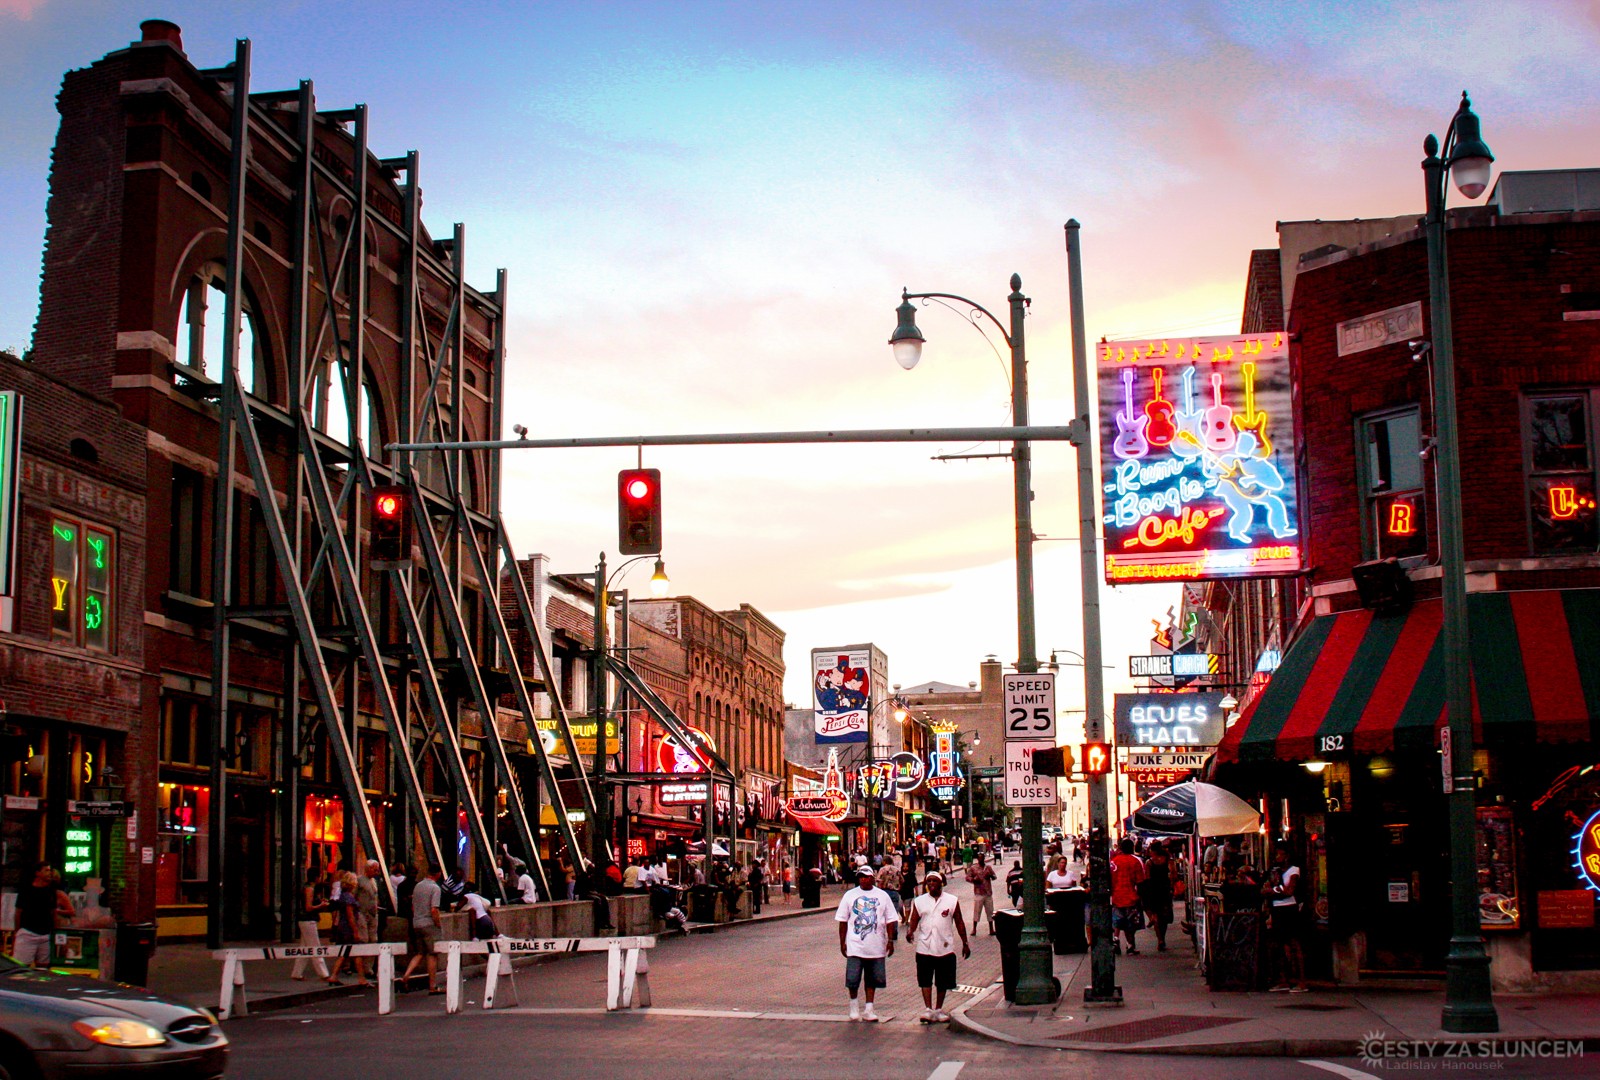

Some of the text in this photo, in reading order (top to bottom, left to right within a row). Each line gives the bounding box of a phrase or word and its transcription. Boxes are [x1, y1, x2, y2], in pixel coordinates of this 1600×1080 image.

[1115, 457, 1184, 496] Rum
[1114, 476, 1205, 528] Boogie
[1138, 506, 1210, 546] Cafe
[1259, 545, 1293, 559] CLUB
[1112, 561, 1193, 579] RESTAURANT
[1130, 656, 1172, 675] STRANGE
[1008, 681, 1051, 691] SPEED
[1013, 694, 1046, 704] LIMIT
[1010, 708, 1051, 730] 25
[1130, 704, 1208, 723] BLUES
[1137, 726, 1200, 743] HALL
[1320, 735, 1344, 752] 182
[1023, 748, 1036, 758] N
[1133, 755, 1204, 765] JUKE JOINT
[1008, 762, 1031, 771] TRU
[1024, 775, 1039, 785] OR
[1138, 773, 1175, 783] CAFE
[1012, 788, 1051, 798] BUSES
[1150, 806, 1185, 817] GUINNESS
[284, 945, 329, 956] BEALE ST.
[510, 941, 556, 951] BEALE ST.
